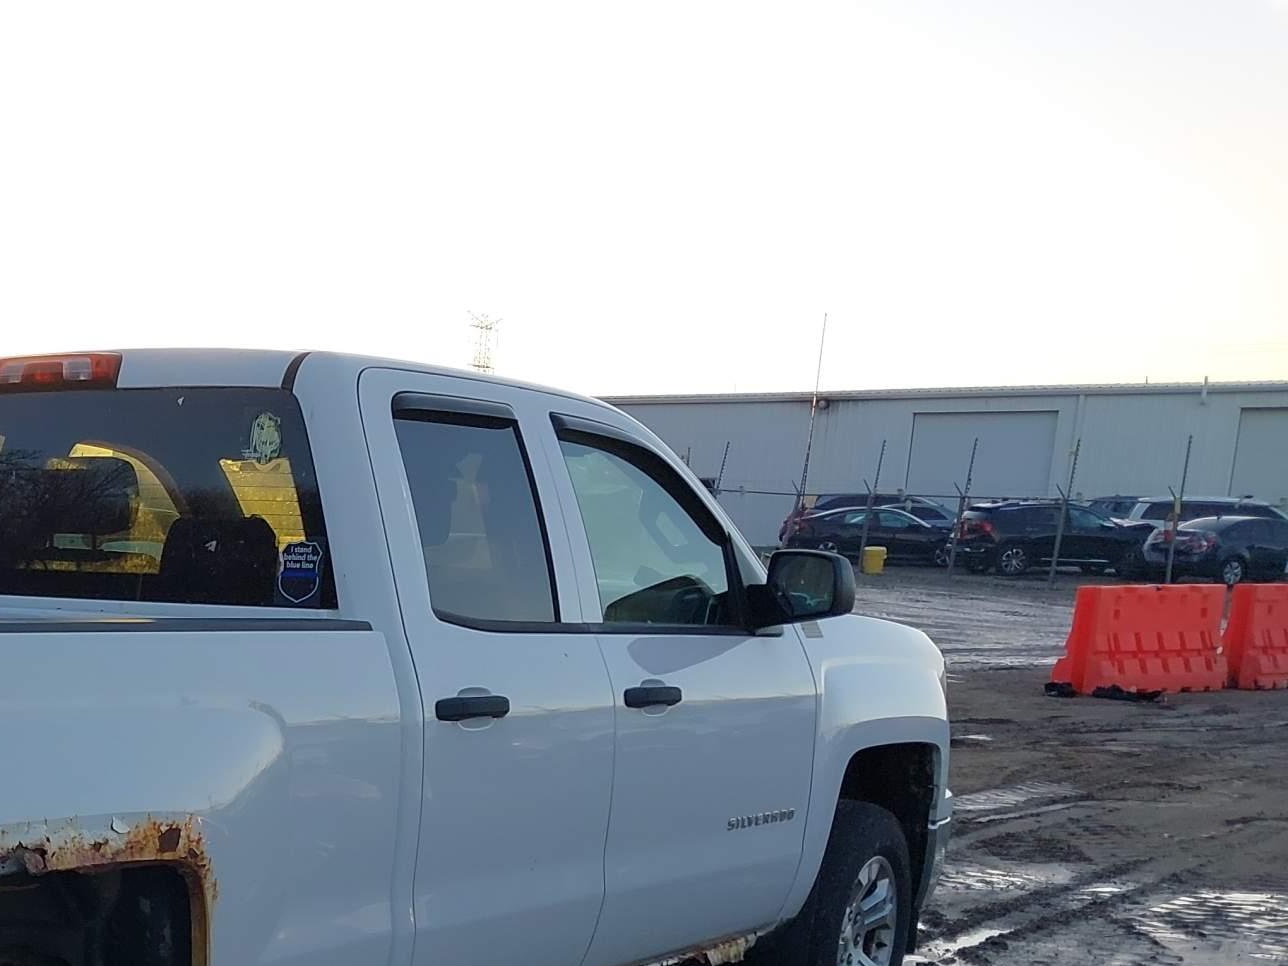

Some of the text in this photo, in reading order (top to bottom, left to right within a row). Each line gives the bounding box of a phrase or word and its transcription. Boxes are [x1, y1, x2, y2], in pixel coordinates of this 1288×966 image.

[295, 545, 312, 553] stand
[284, 553, 317, 561] behind the
[286, 561, 314, 569] blue line
[727, 807, 795, 832] SILVERADO
